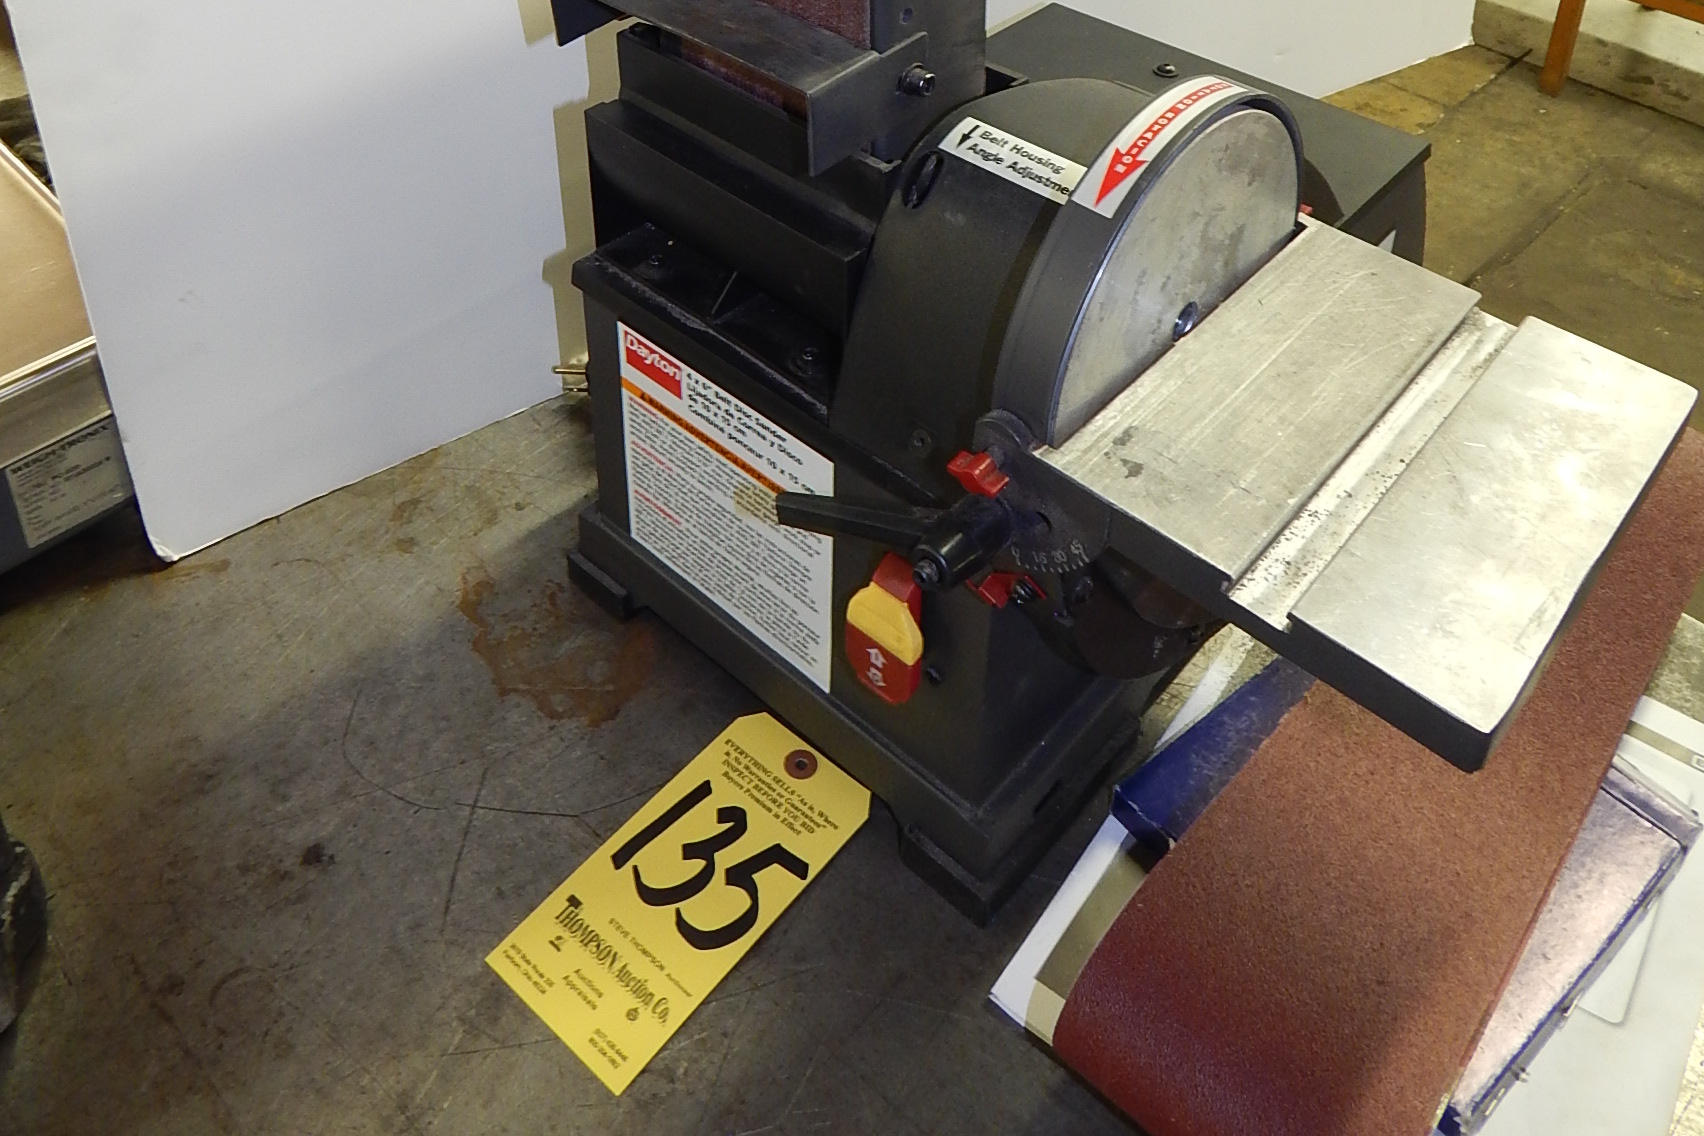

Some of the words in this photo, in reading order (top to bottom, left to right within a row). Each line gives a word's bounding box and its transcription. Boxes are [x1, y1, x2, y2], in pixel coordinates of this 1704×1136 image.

[967, 142, 1005, 166] Angle
[978, 129, 1010, 153] Belt
[1011, 144, 1065, 175] Housing
[625, 332, 680, 381] Dayton
[715, 389, 732, 408] Belt
[754, 415, 787, 445] Sander
[721, 759, 753, 785] INSPECT
[752, 783, 784, 809] BEFORE
[782, 806, 802, 823] YOU
[799, 820, 816, 834] BID
[724, 738, 773, 778] EVERYTHING
[770, 775, 796, 796] SELLS
[815, 810, 840, 831] Where
[732, 756, 743, 766] No
[742, 763, 777, 792] Warranties
[721, 770, 745, 790] Buyers
[743, 788, 774, 813] Premium
[780, 817, 802, 836] Effect
[610, 779, 810, 951] 135
[553, 893, 620, 970] THOMPSON
[613, 962, 657, 1007] Auction
[607, 917, 629, 938] STEVE
[628, 936, 665, 972] THOMPSON
[561, 973, 598, 1011] Appraisals
[573, 967, 604, 999] Auctions
